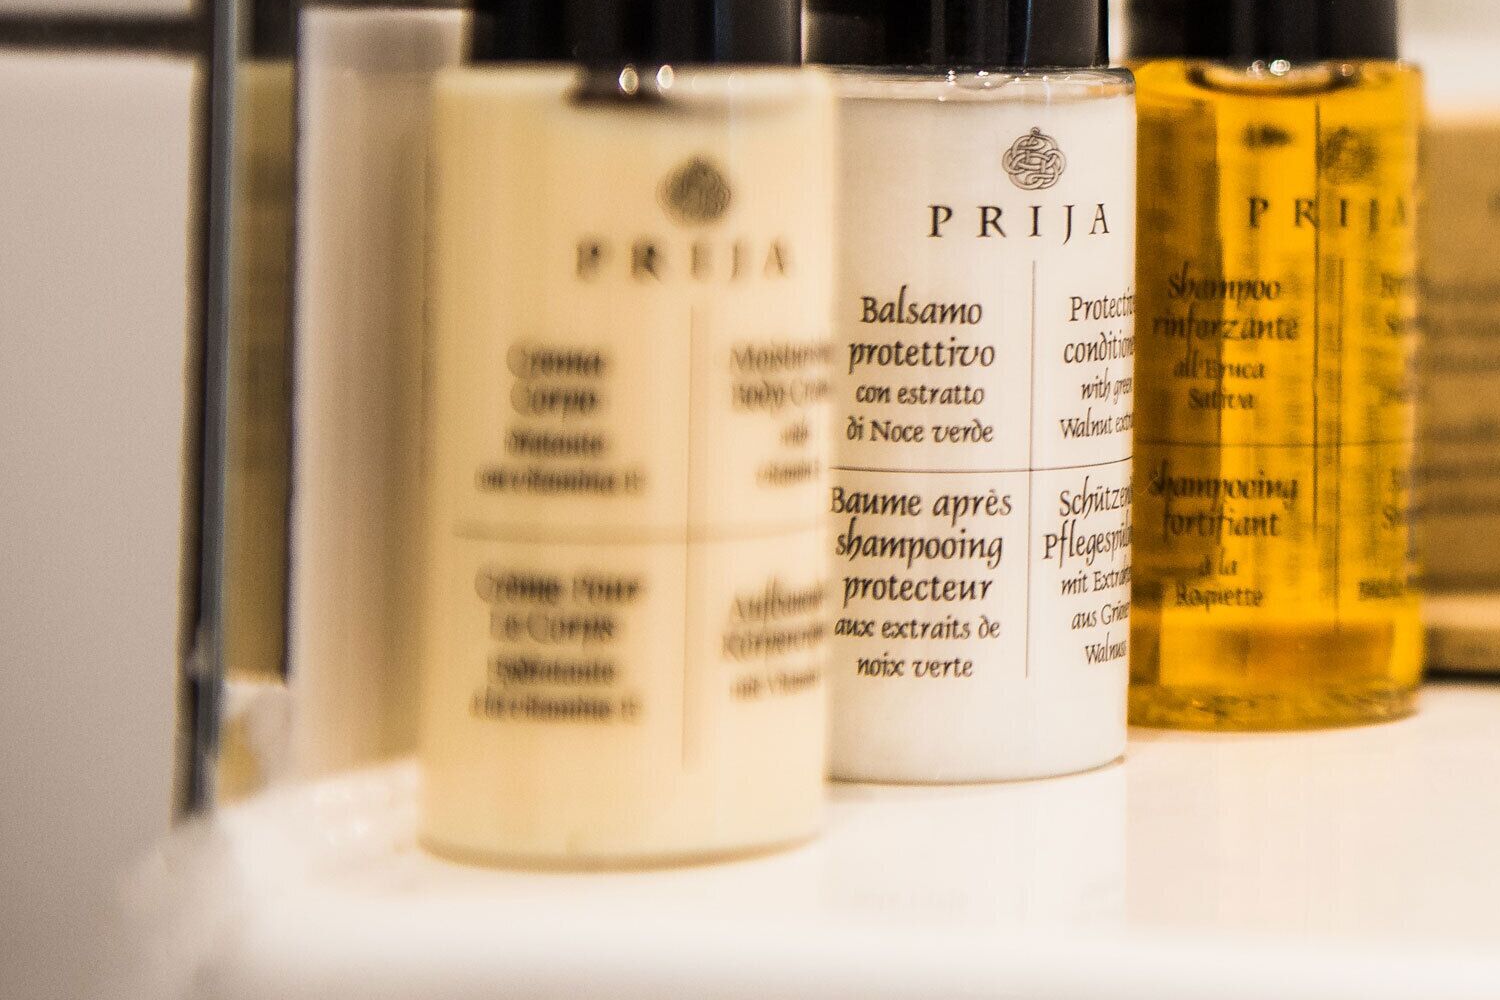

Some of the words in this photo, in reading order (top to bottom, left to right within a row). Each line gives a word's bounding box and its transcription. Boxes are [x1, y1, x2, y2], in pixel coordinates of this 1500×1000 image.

[926, 202, 1110, 246] PRIJA
[574, 237, 795, 283] PRIJA
[859, 284, 984, 325] Balsamo
[848, 336, 996, 376] protettivo
[855, 382, 891, 405] con
[897, 380, 986, 406] estratto
[1080, 366, 1111, 403] with
[846, 414, 865, 442] di
[870, 419, 925, 443] Noce
[932, 415, 994, 443] verde
[1060, 406, 1113, 441] Walnut
[830, 486, 921, 516] Baume
[932, 489, 1012, 527] après
[835, 517, 1003, 571] shampooing
[842, 573, 993, 609] protecteur
[1061, 569, 1088, 596] mit
[834, 617, 874, 639] aux
[881, 613, 970, 640] extraits
[978, 615, 1001, 639] de
[1071, 610, 1097, 631] aus
[856, 652, 903, 678] noix
[911, 655, 973, 679] verte
